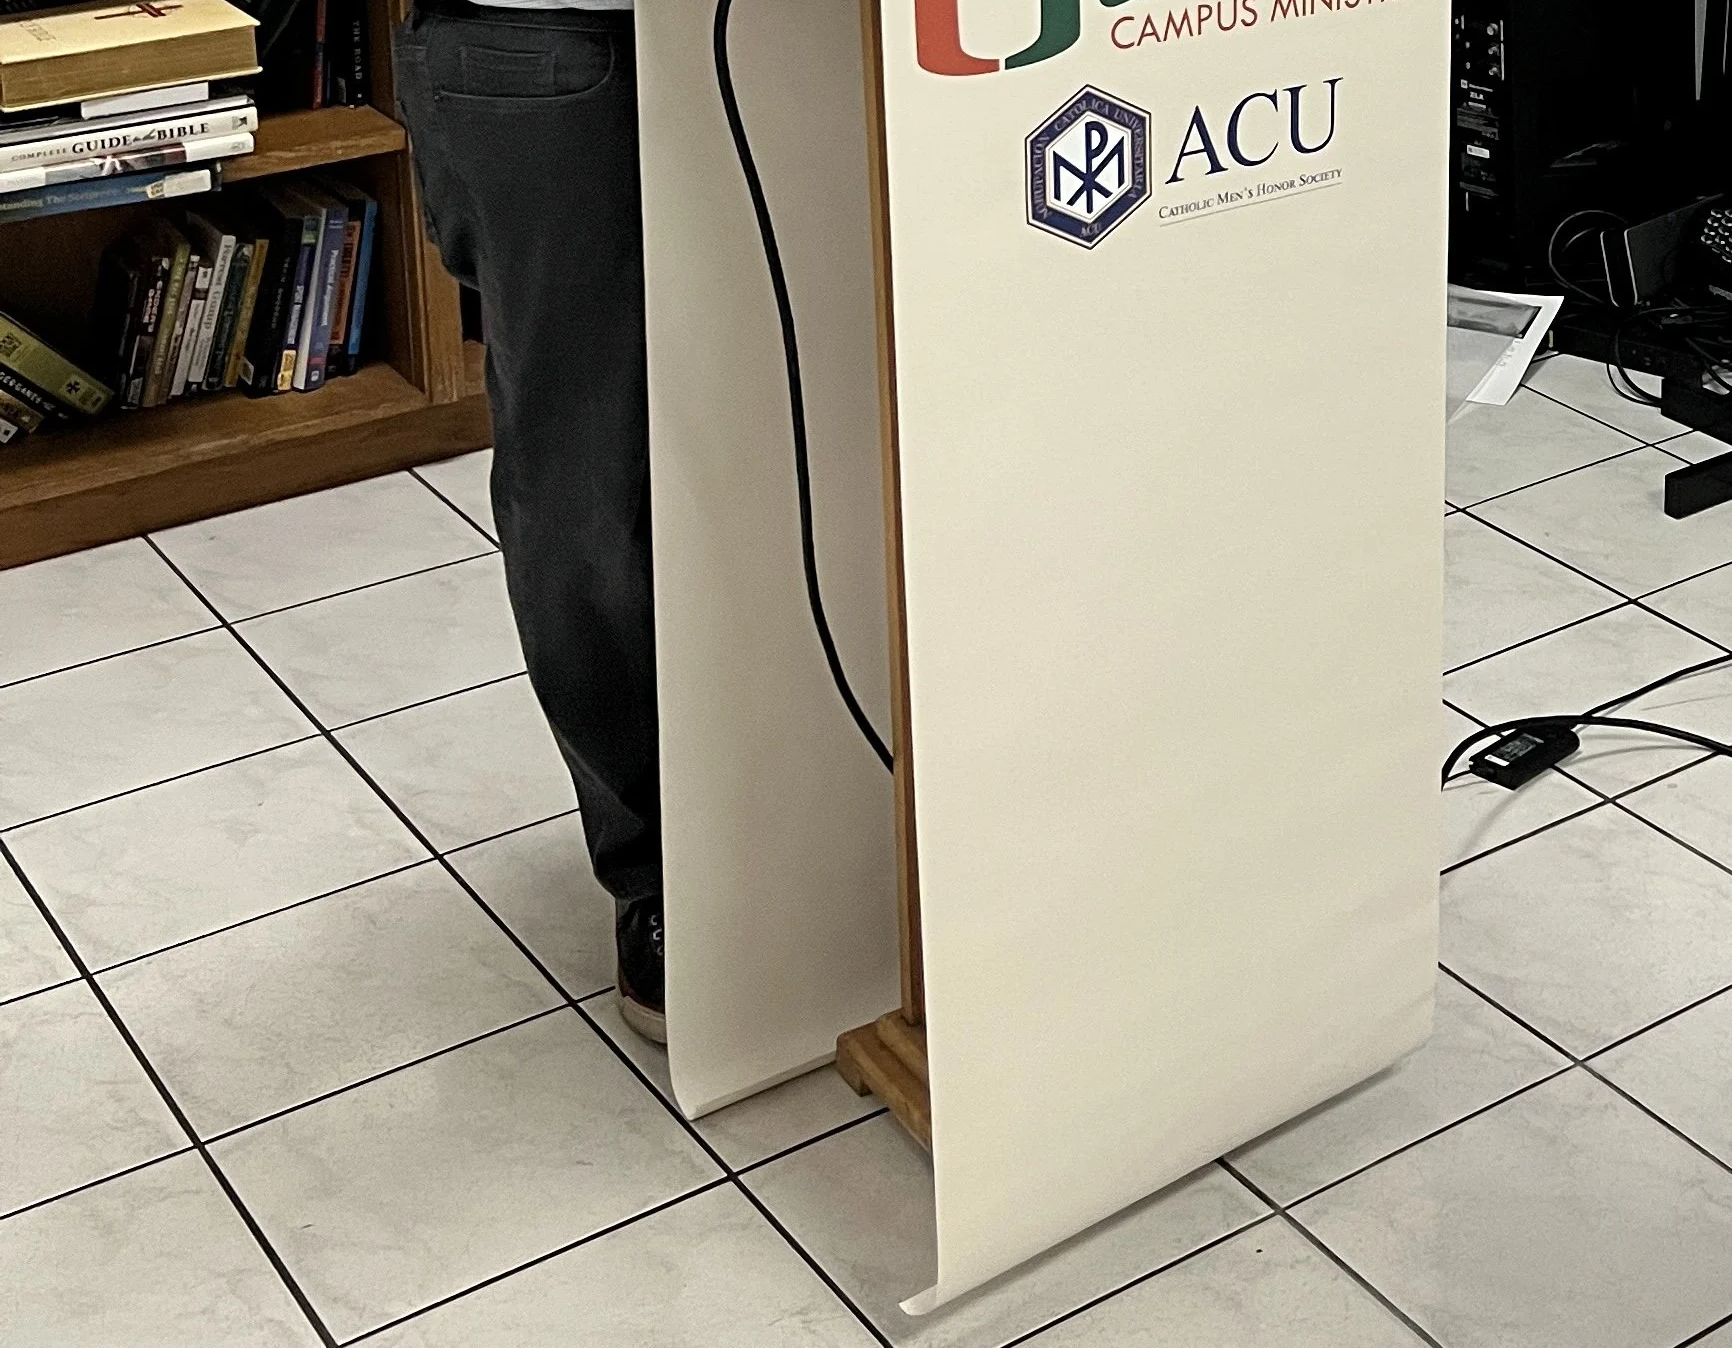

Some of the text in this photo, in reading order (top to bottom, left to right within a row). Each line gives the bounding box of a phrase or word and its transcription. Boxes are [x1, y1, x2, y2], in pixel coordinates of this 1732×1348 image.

[352, 19, 363, 80] THE ROAD
[11, 146, 68, 162] COMPLETE
[72, 135, 133, 154] GUIDE
[157, 122, 210, 140] BIBLE
[1165, 76, 1344, 185] ACU
[204, 244, 234, 330] Forrest Gump
[326, 249, 340, 283] Practical
